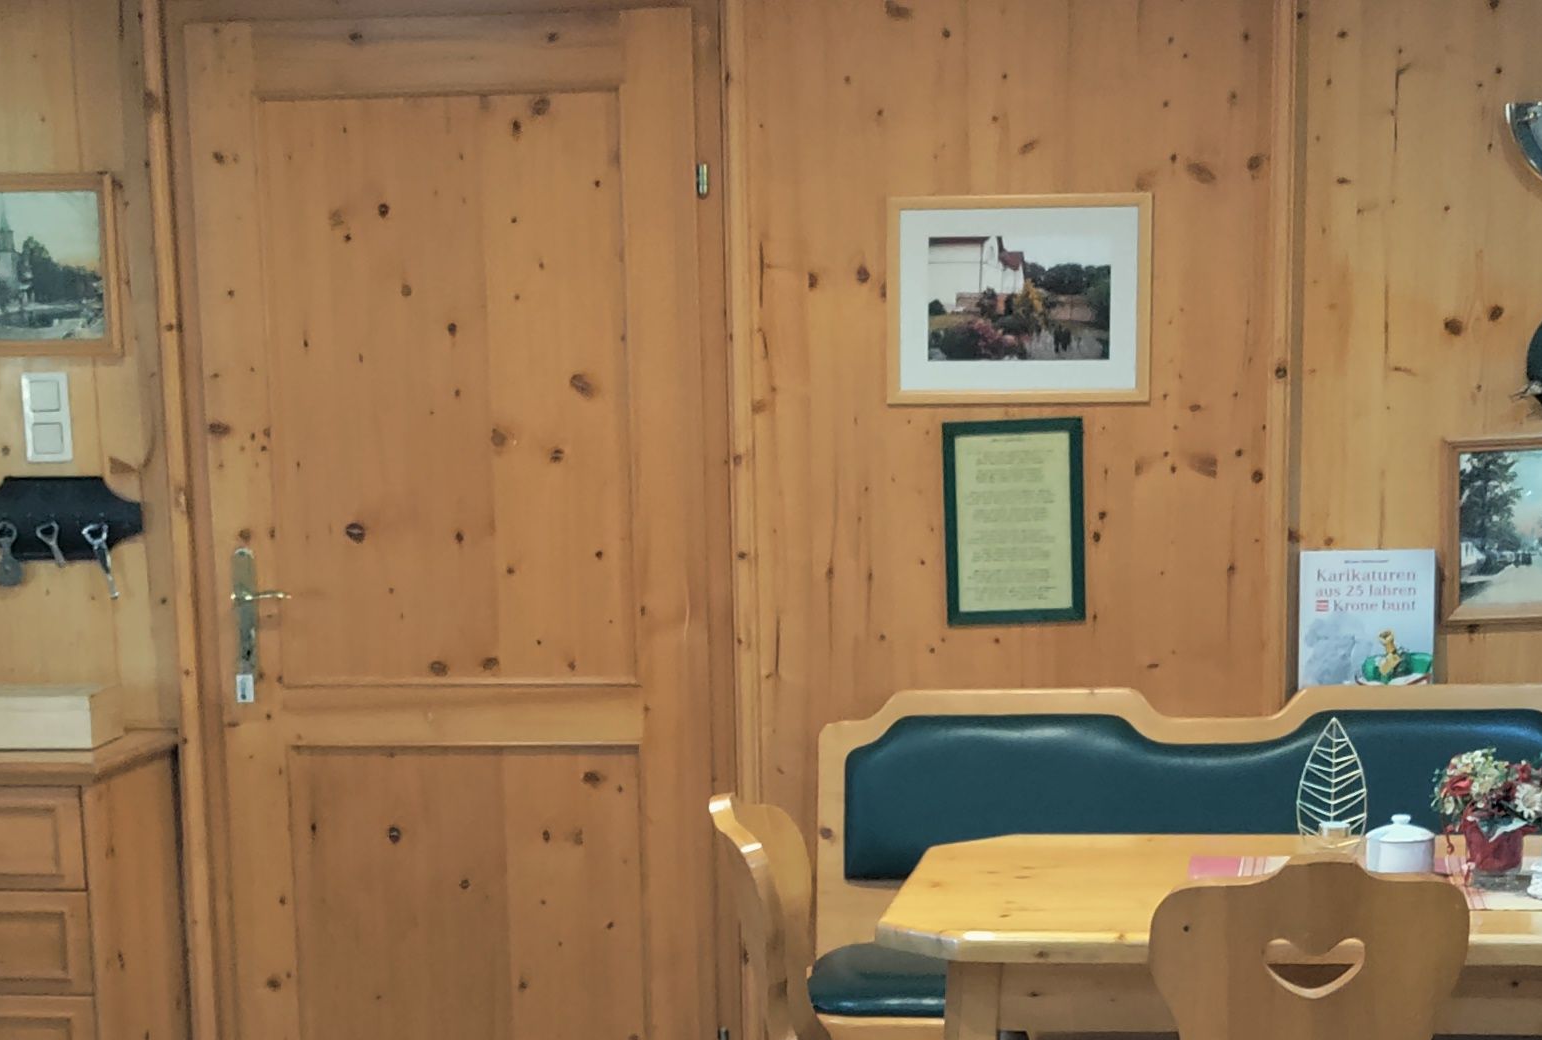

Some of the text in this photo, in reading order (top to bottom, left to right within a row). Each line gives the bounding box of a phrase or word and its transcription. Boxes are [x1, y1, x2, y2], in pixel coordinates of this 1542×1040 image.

[1316, 567, 1417, 582] Karikaturen
[1316, 584, 1417, 597] aus 25 Jahren
[1333, 600, 1378, 612] Krone
[1381, 599, 1417, 611] bunt
